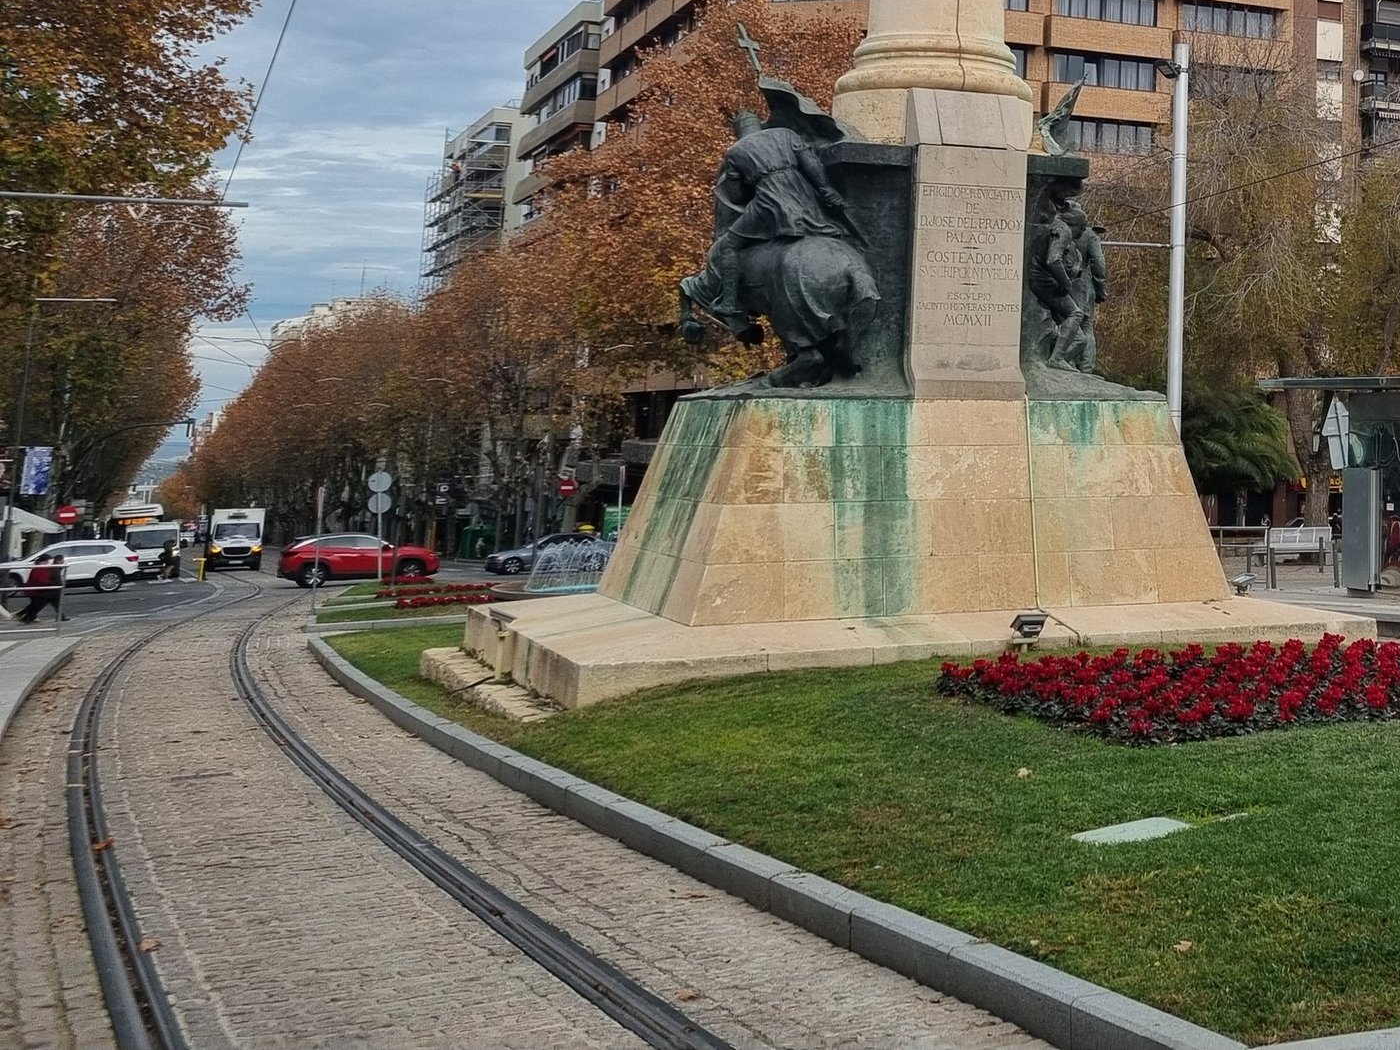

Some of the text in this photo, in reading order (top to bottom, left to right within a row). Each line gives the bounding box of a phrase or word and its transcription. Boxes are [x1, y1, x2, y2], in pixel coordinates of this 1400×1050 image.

[922, 185, 960, 199] ERIGIDO
[965, 202, 980, 215] DE
[957, 217, 977, 229] DEL
[979, 218, 1015, 231] PRADO
[946, 231, 997, 245] PALACIO
[926, 250, 1014, 266] COSTEADO POR
[943, 313, 992, 327] MCMXII
